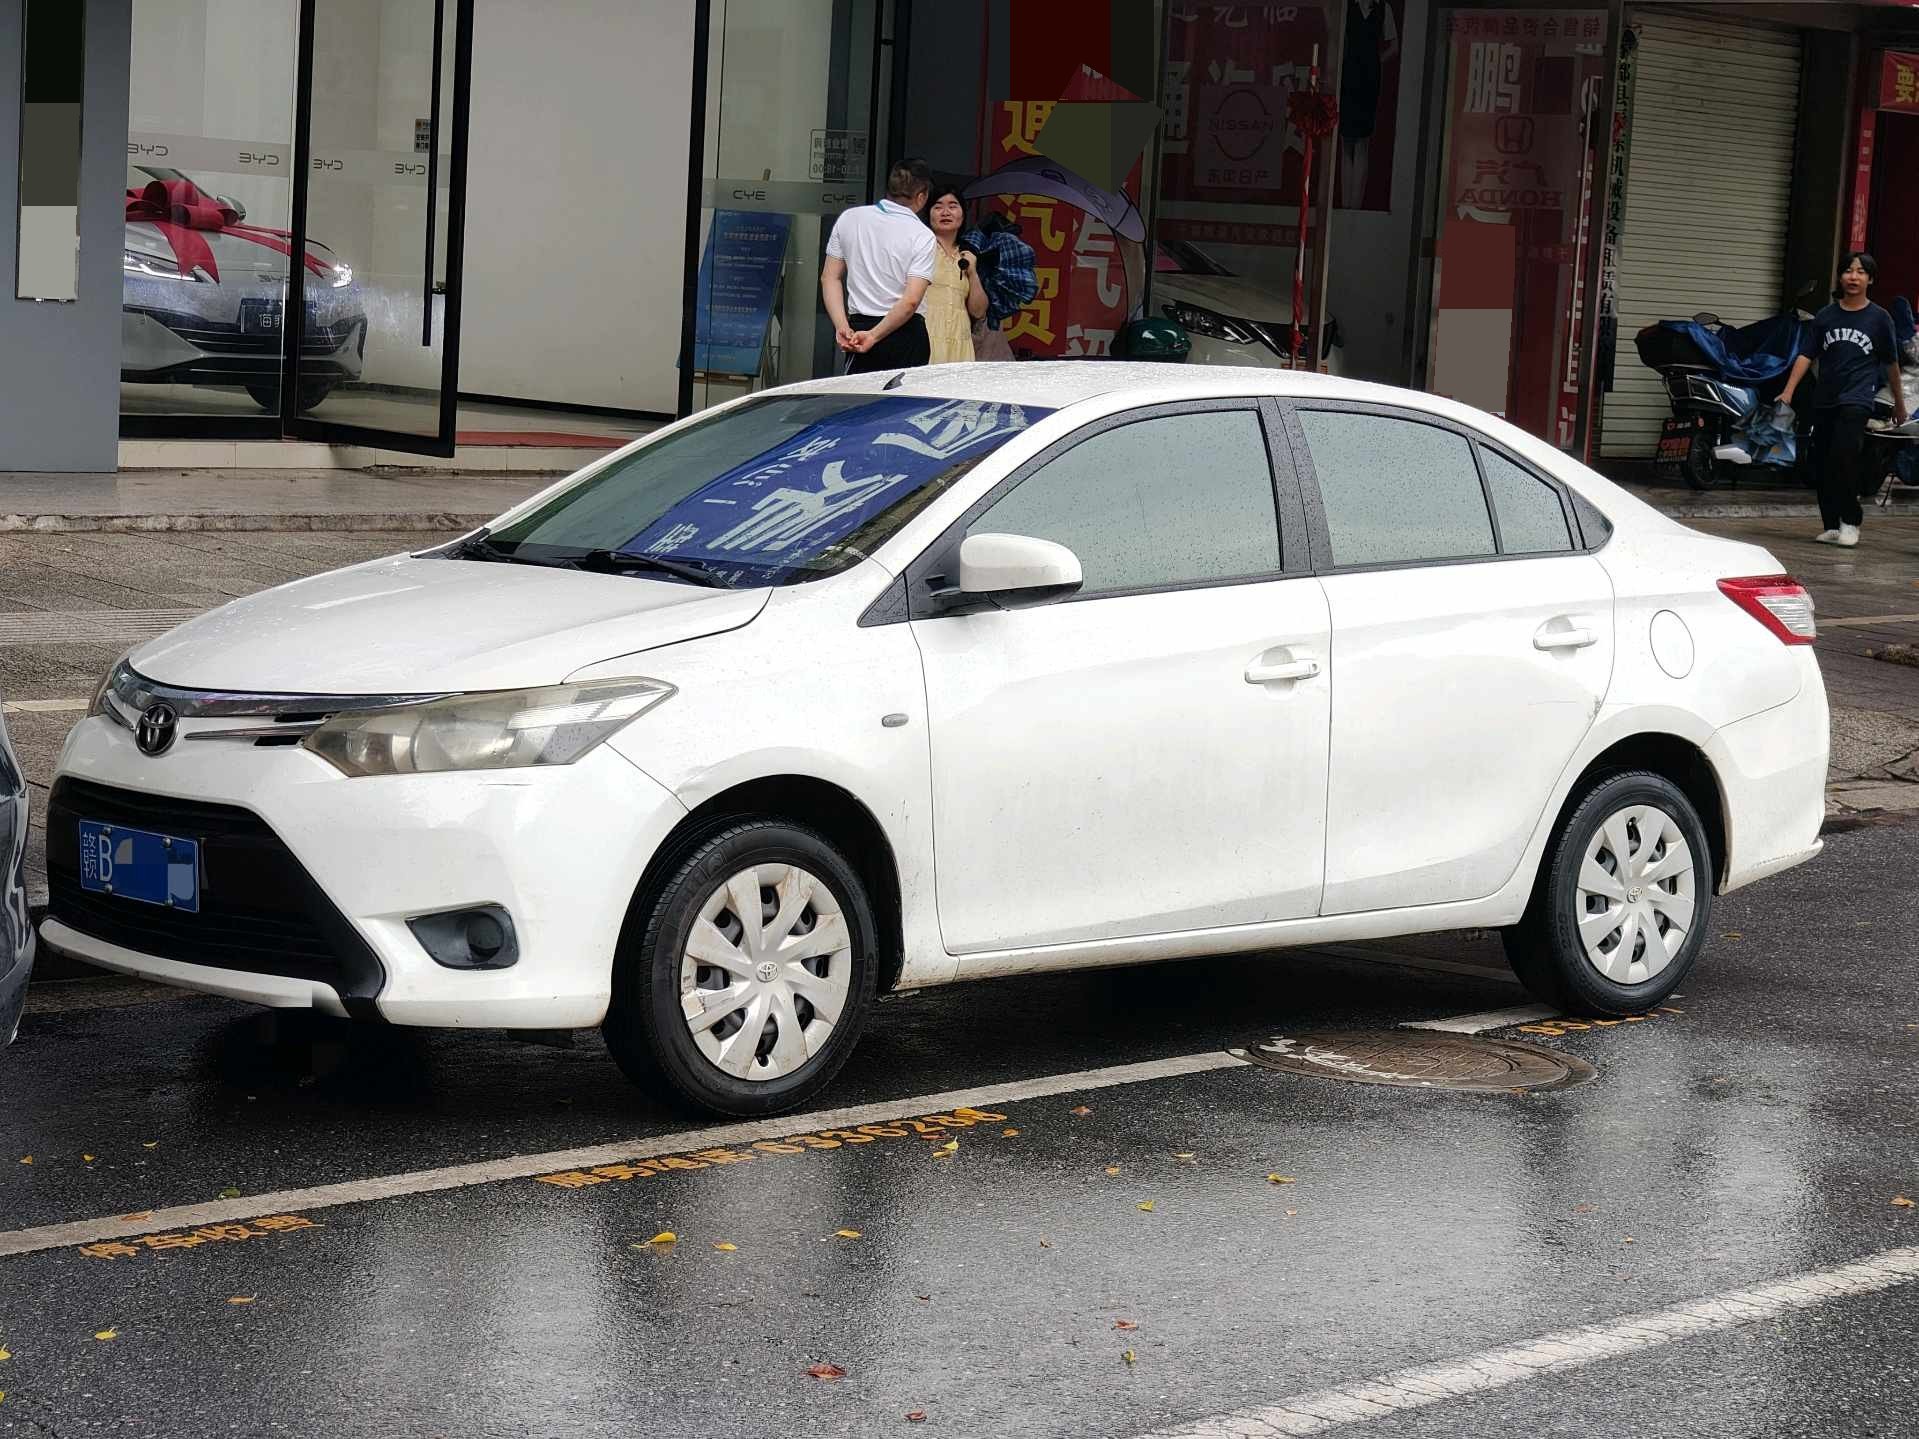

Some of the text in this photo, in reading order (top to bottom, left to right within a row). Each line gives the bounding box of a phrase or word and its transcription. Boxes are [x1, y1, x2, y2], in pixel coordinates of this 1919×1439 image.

[1209, 119, 1274, 131] NISSAN
[127, 143, 168, 157] BYD
[239, 152, 280, 166] BYD
[313, 158, 343, 170] BYD
[394, 163, 426, 175] BYD
